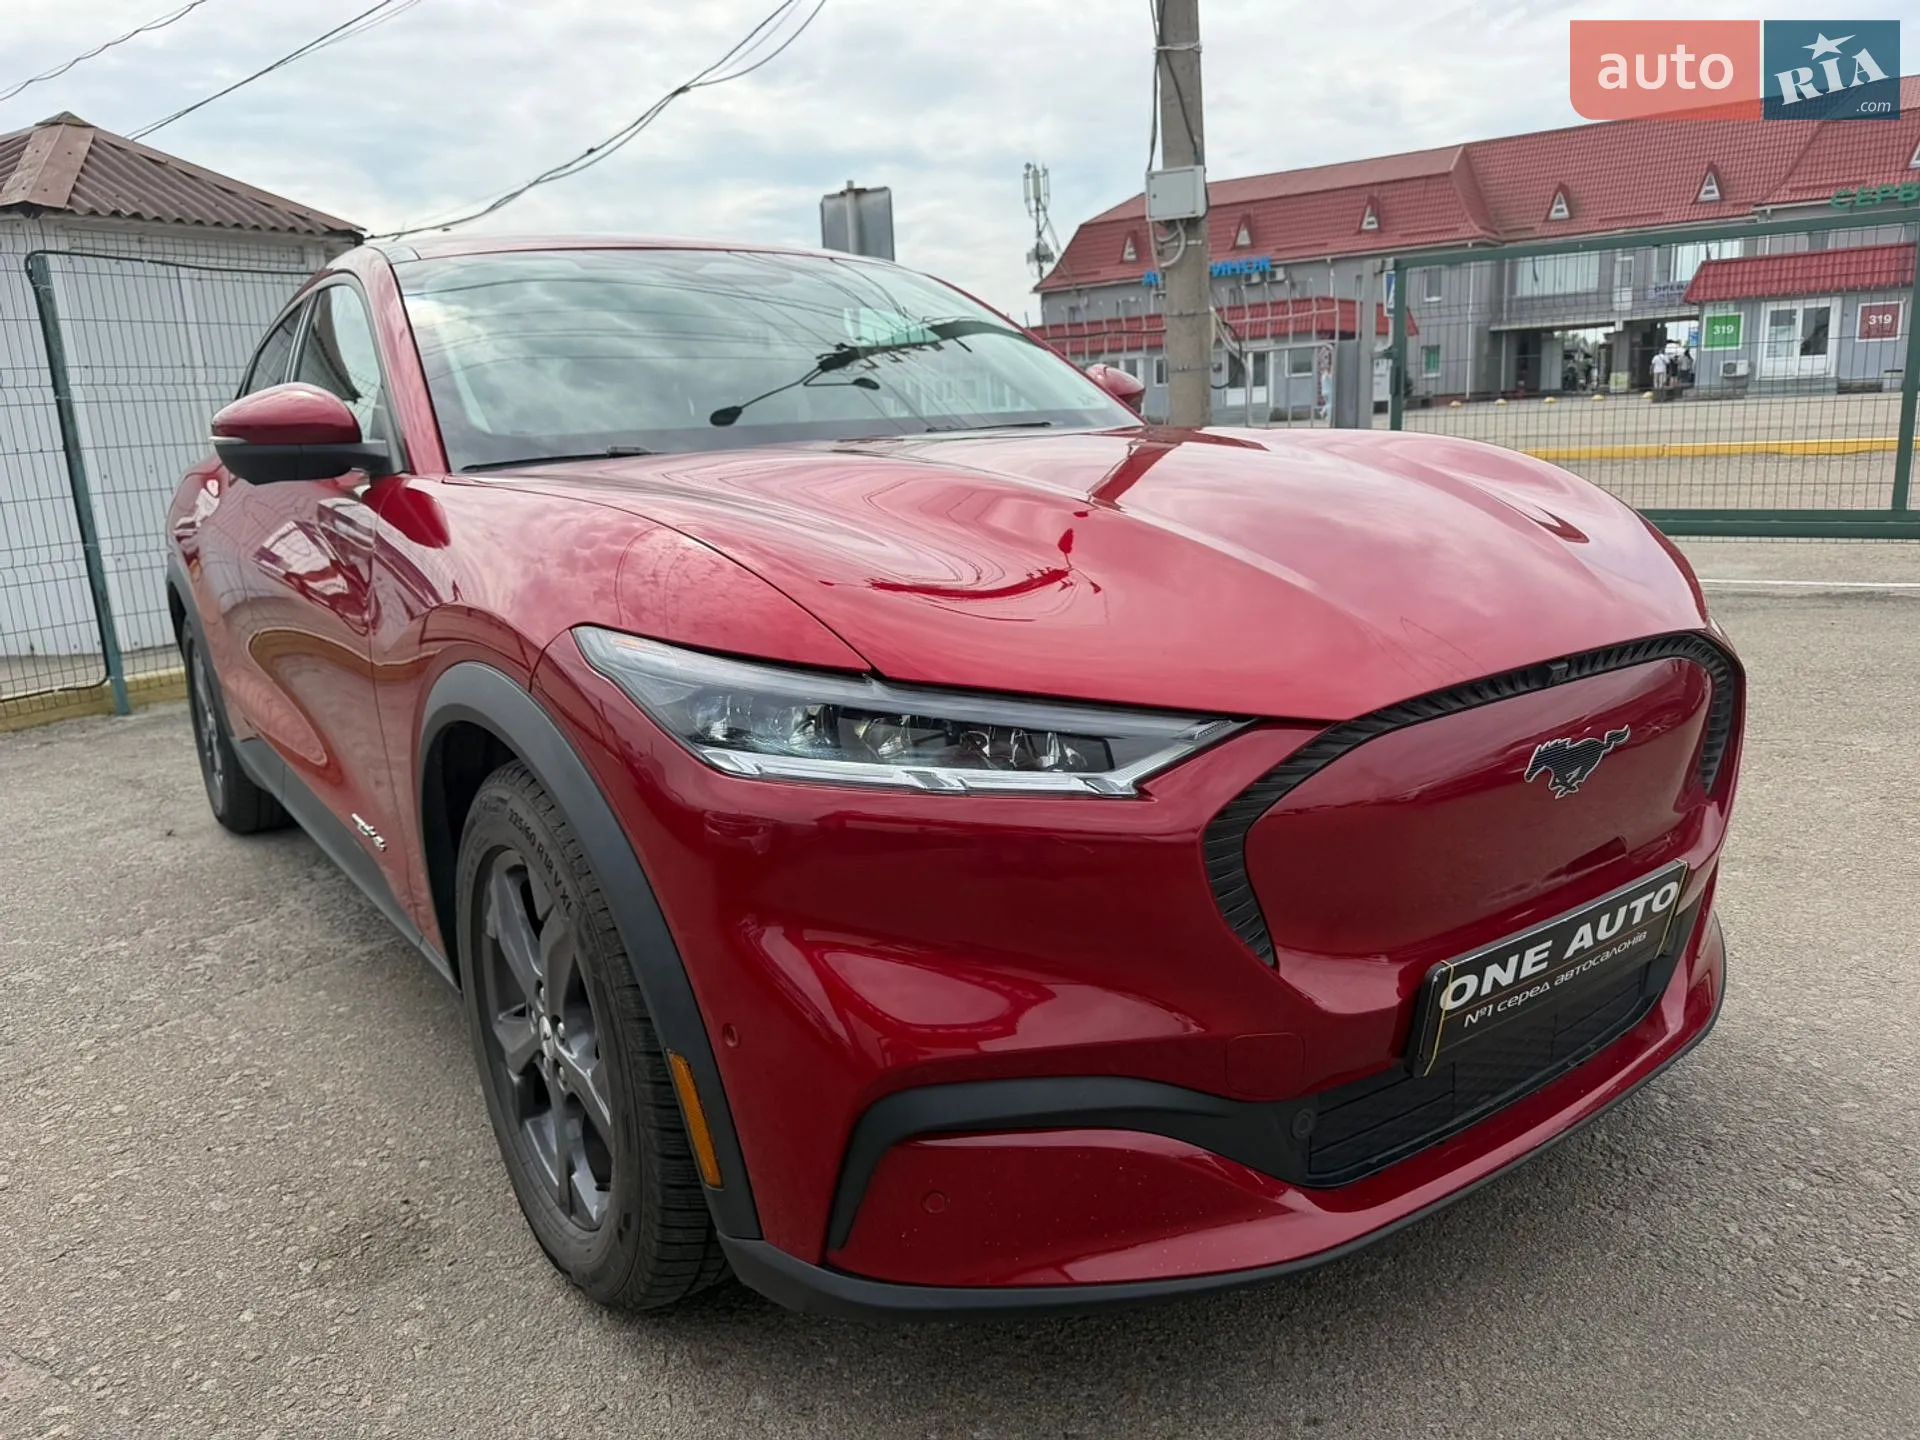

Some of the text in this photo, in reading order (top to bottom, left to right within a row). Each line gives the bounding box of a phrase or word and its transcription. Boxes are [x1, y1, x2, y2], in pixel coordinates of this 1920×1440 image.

[1713, 324, 1734, 335] 319
[1868, 313, 1892, 325] 319
[1439, 880, 1679, 1011] ONE AUTO
[1497, 982, 1550, 1013] серед
[1553, 930, 1648, 987] автосалонів
